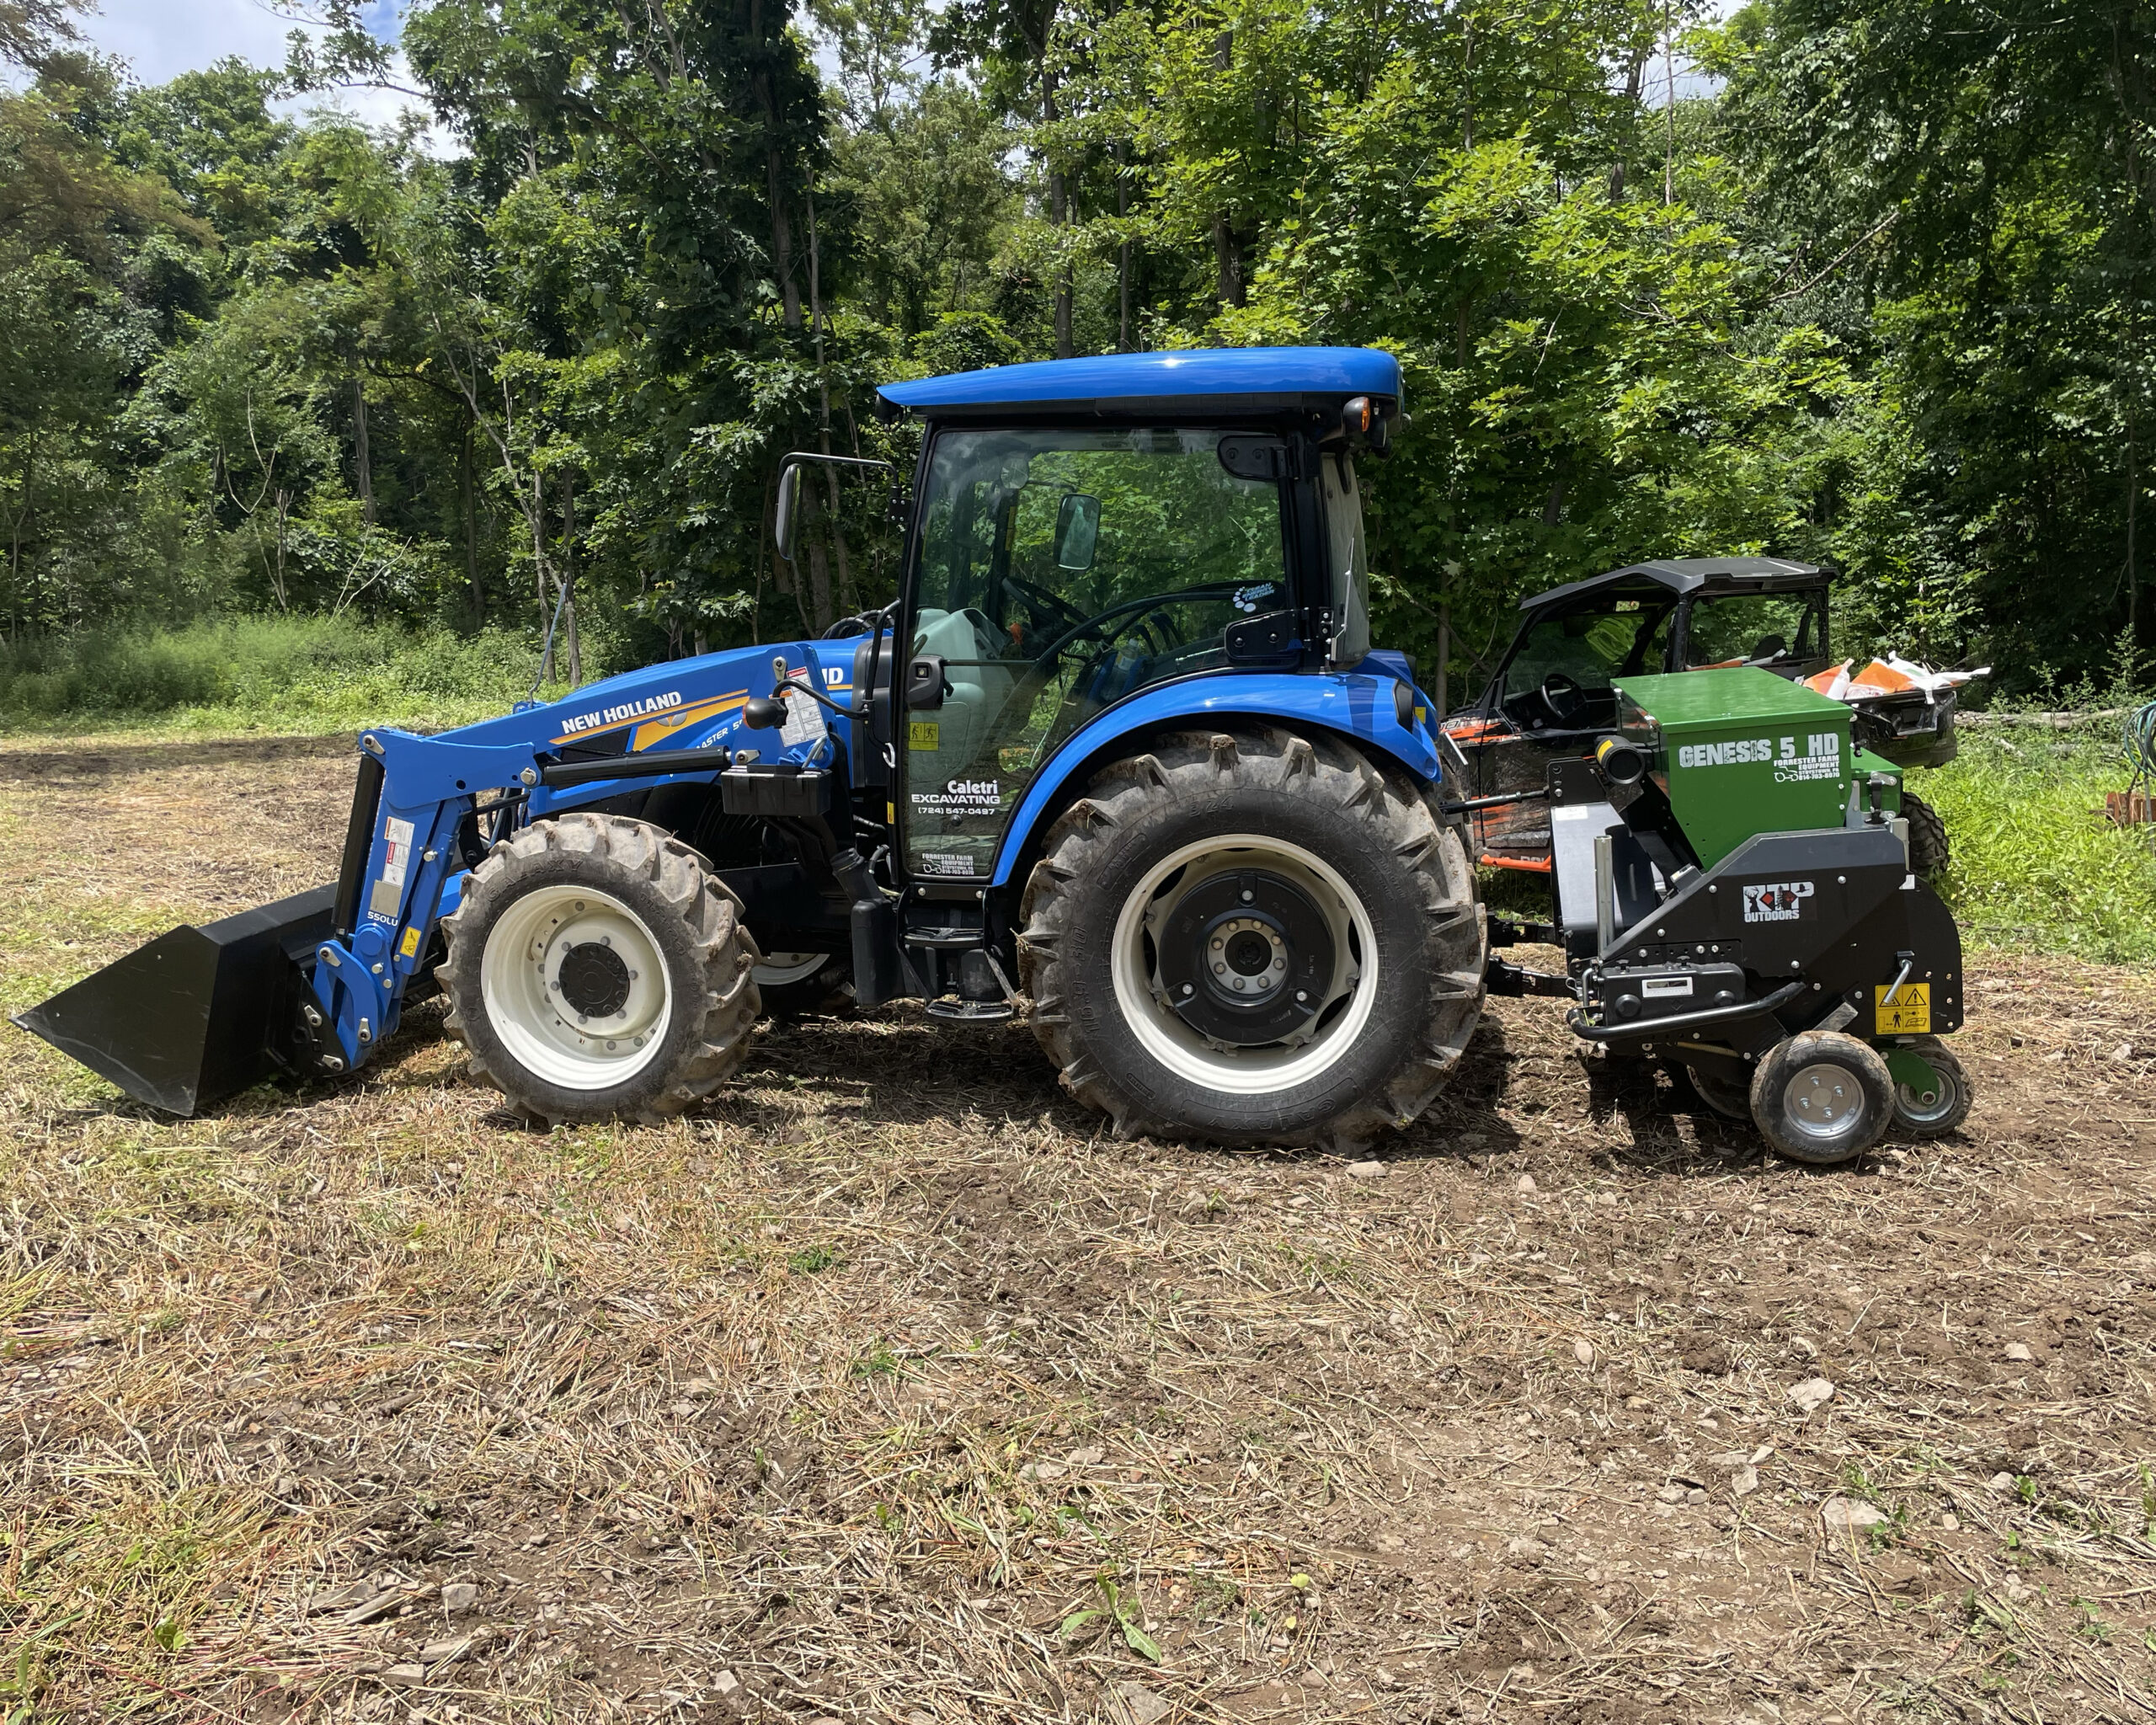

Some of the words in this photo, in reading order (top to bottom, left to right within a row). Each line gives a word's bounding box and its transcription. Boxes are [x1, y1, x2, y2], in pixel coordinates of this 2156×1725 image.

[562, 711, 600, 734] NEW
[603, 691, 681, 724] HOLLAND
[696, 727, 728, 749] ASTER
[1679, 739, 1772, 768] GENESIS
[1780, 736, 1796, 758] 5
[1808, 733, 1839, 756] HD
[1773, 757, 1817, 766] FORRESTER
[1798, 761, 1840, 771] EQUIPMENT
[947, 780, 998, 794] Caletri
[911, 793, 1001, 804] EXCAVATING
[367, 911, 398, 927] 550LU
[1744, 910, 1800, 922] OUTDOORS
